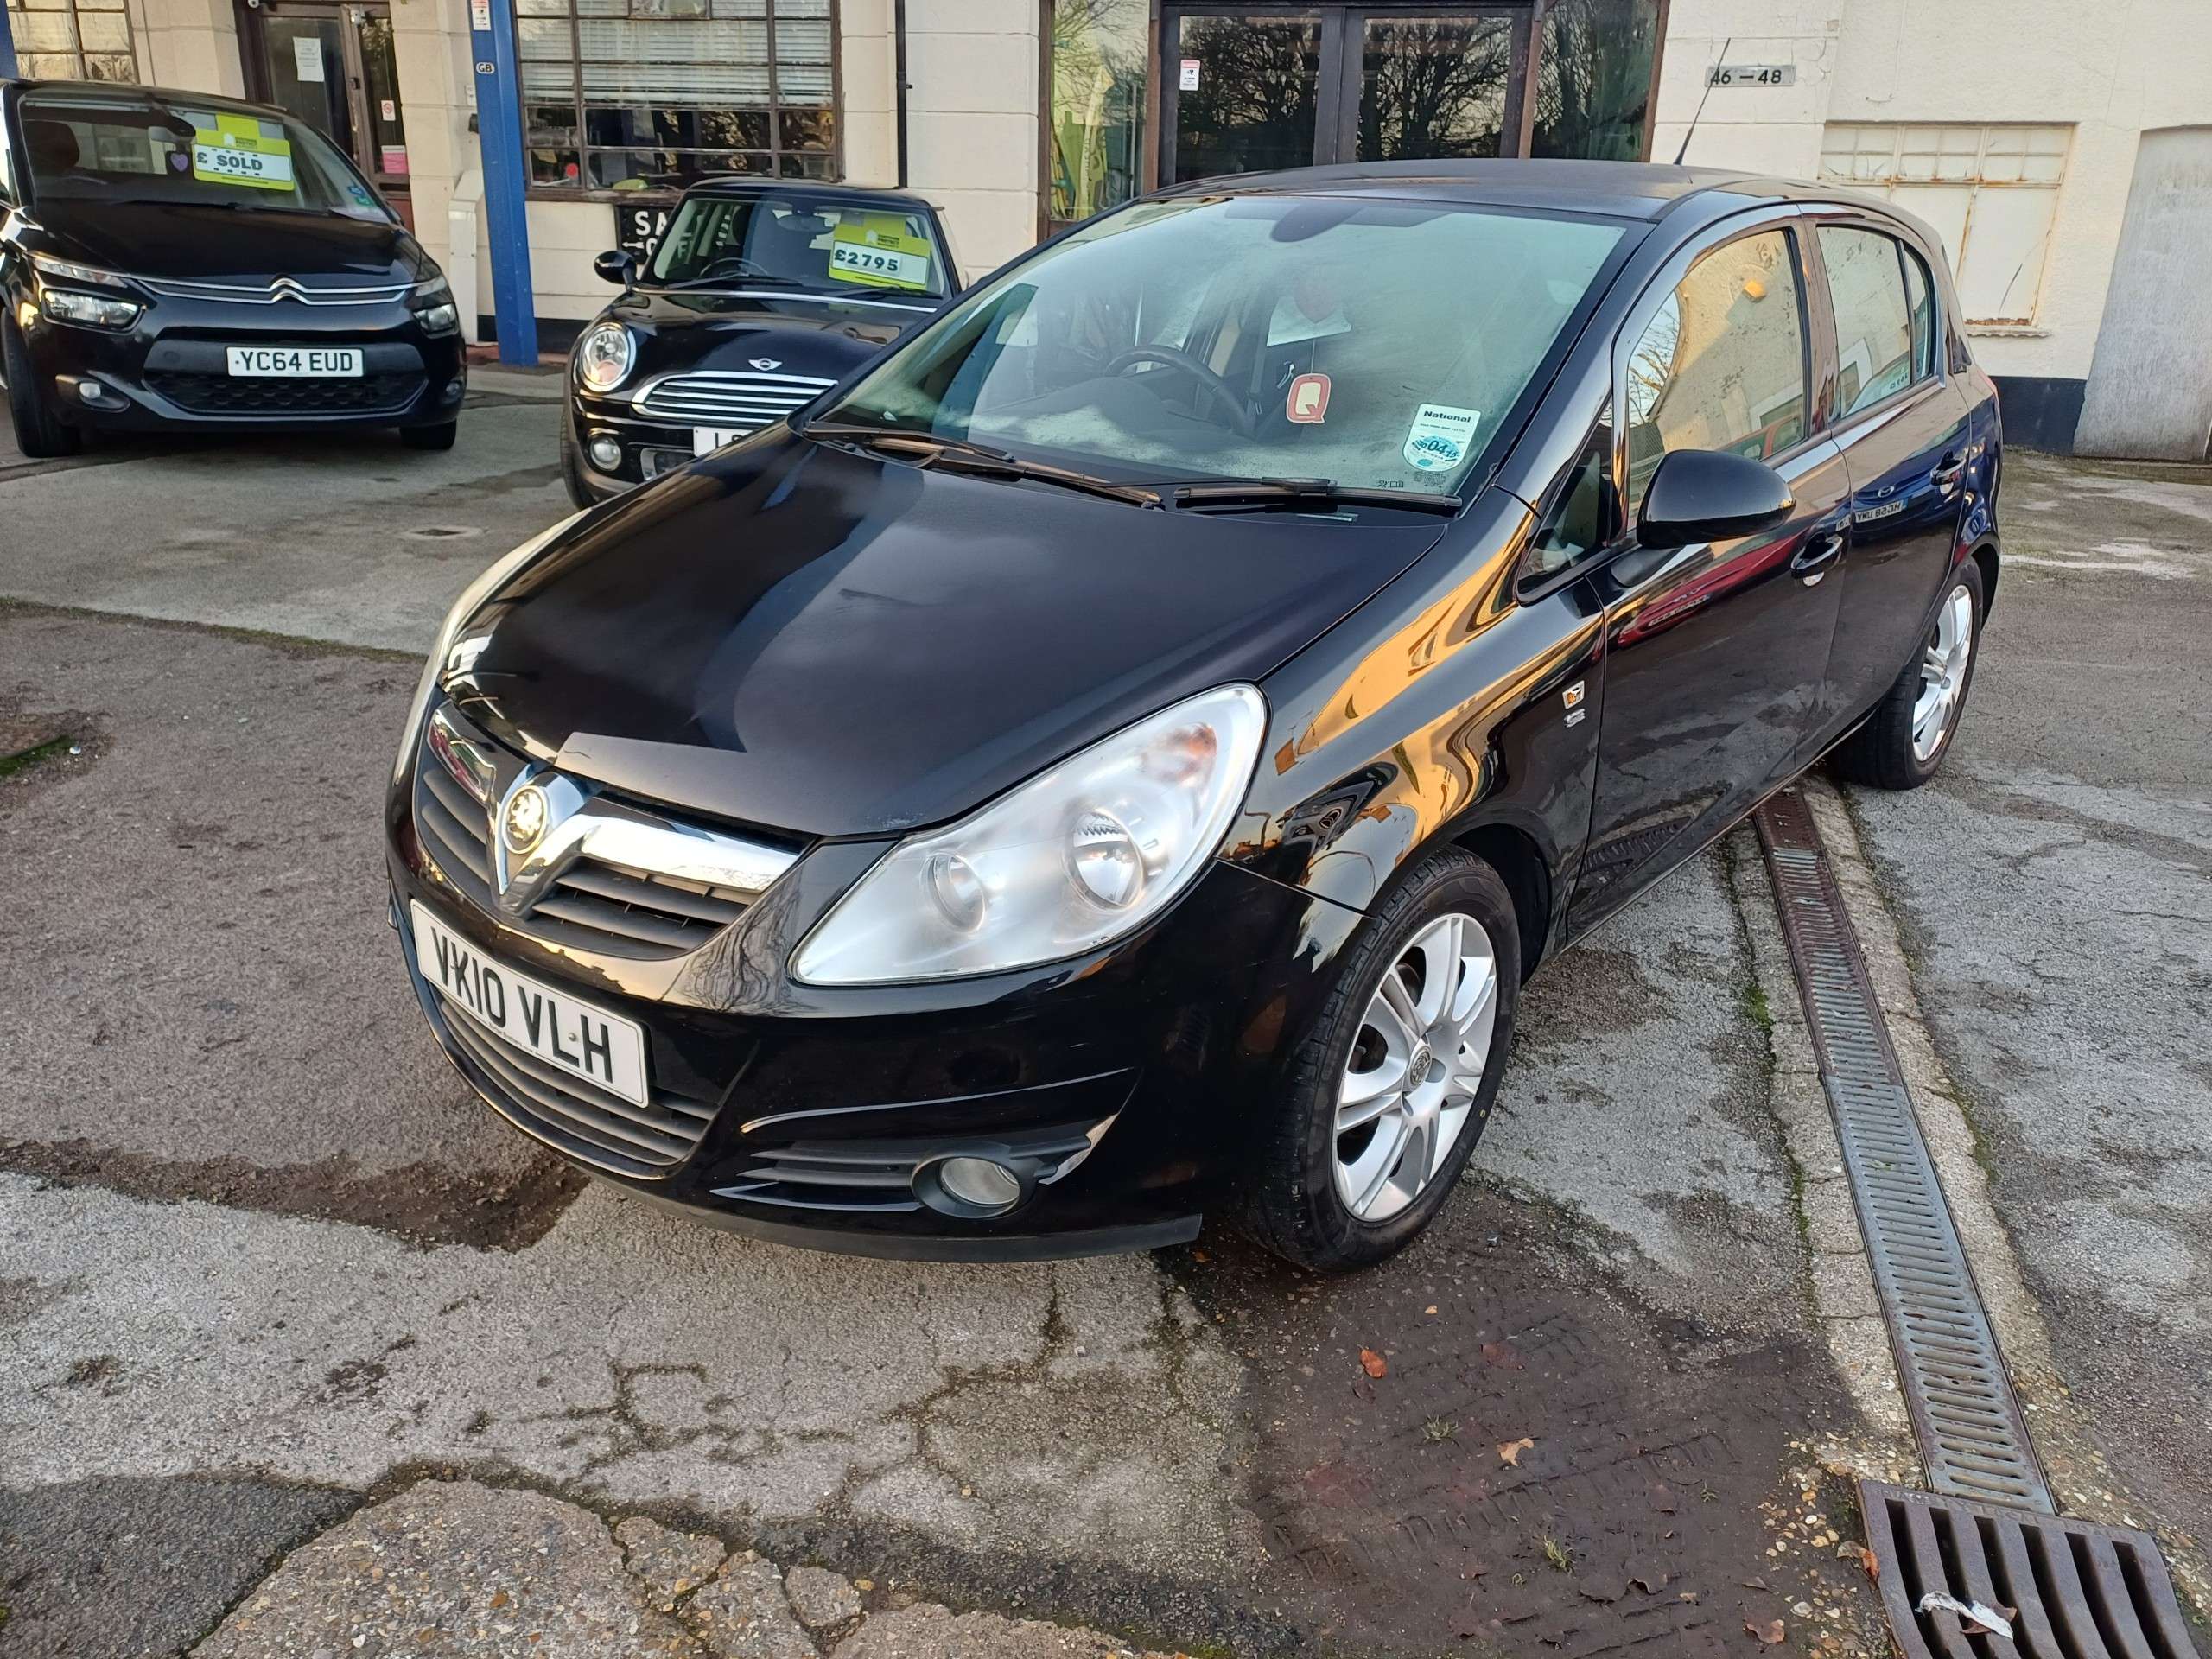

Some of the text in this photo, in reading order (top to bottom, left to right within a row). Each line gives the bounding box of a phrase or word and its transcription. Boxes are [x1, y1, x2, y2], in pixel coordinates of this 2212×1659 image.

[478, 63, 493, 73] GB
[216, 155, 263, 171] SOLD
[835, 249, 899, 271] £2795
[240, 351, 353, 372] YC64 EUD
[1423, 410, 1471, 423] National
[431, 926, 613, 1084] VK10 VLH
